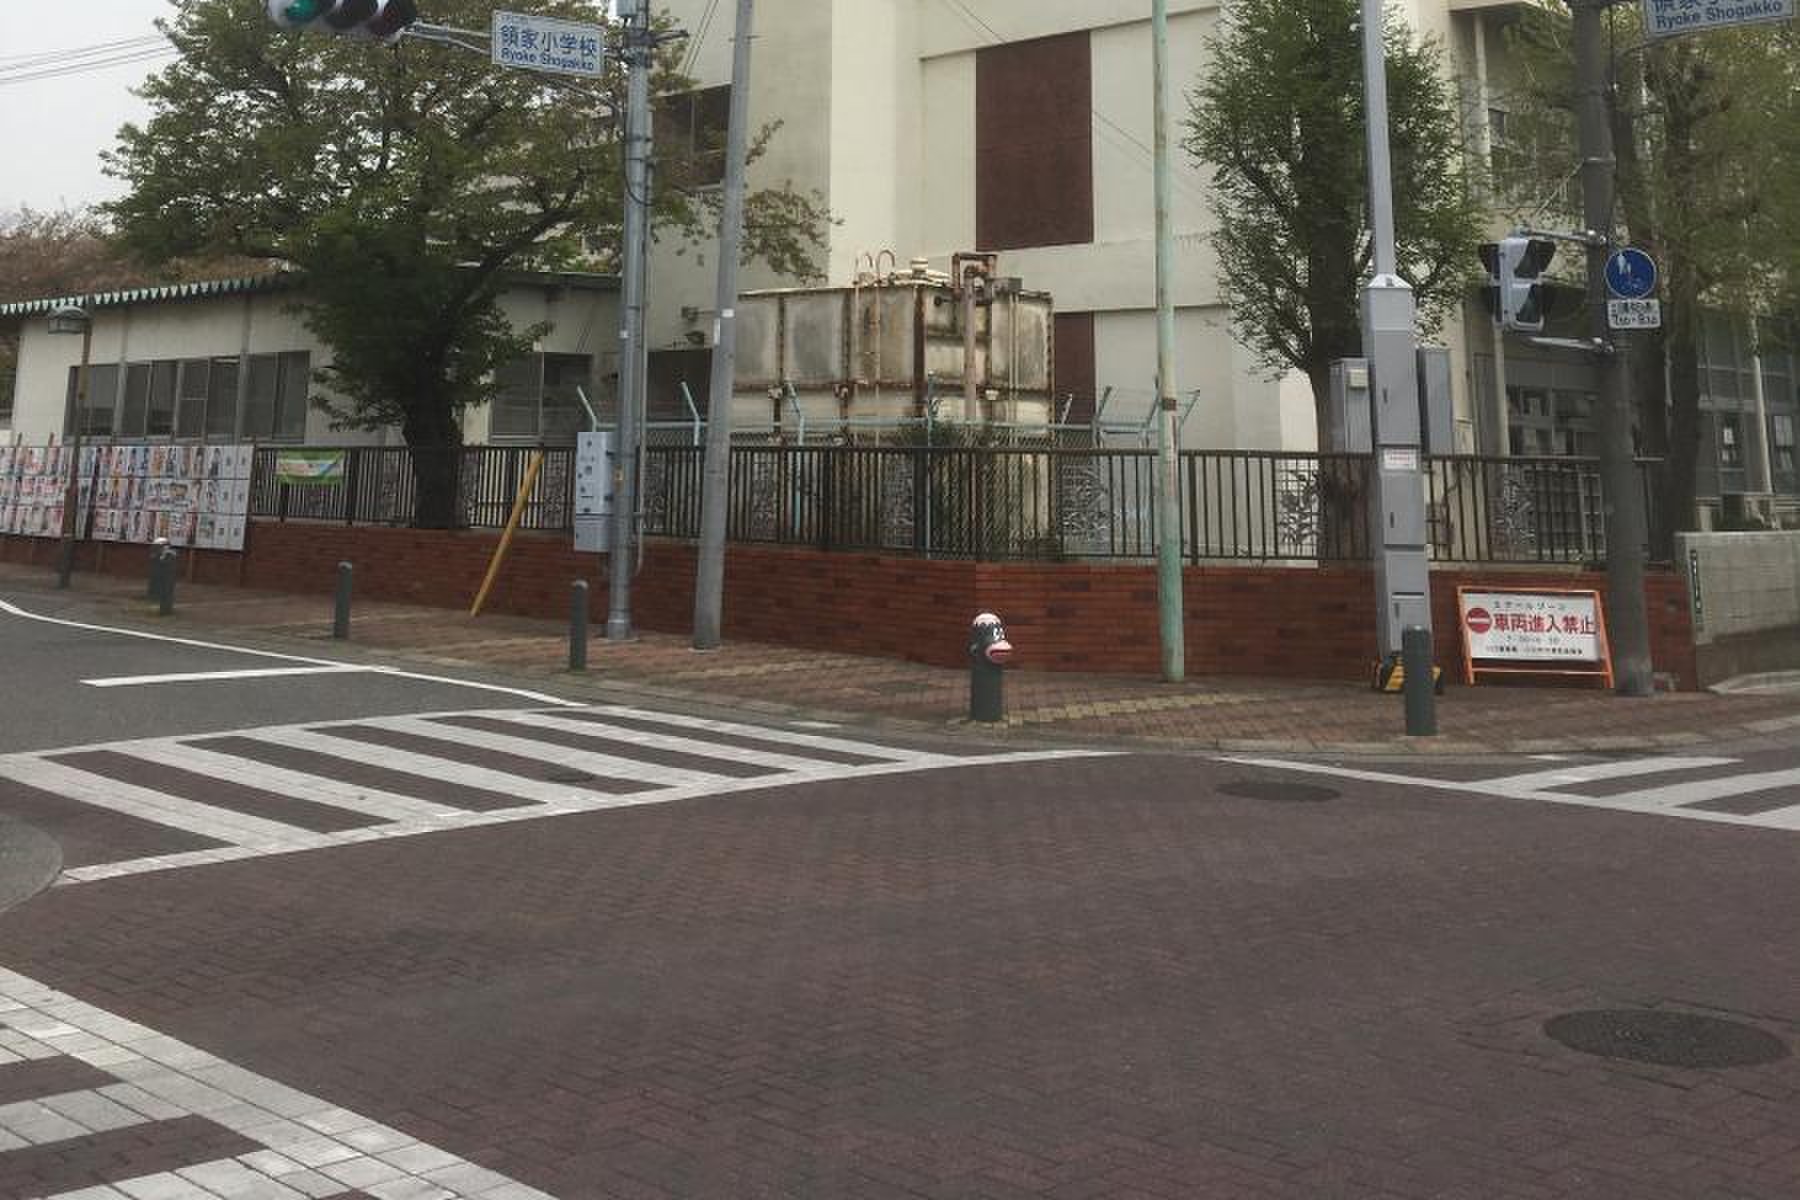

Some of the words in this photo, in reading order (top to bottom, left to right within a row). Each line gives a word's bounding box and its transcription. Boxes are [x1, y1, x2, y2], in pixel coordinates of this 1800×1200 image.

[1656, 12, 1700, 29] Ryoke
[1705, 0, 1783, 22] Shogakko
[500, 24, 598, 59] 領家小学校
[500, 47, 537, 64] Ryoke
[541, 51, 594, 71] Shogakko
[1493, 613, 1597, 636] 車両進入禁止
